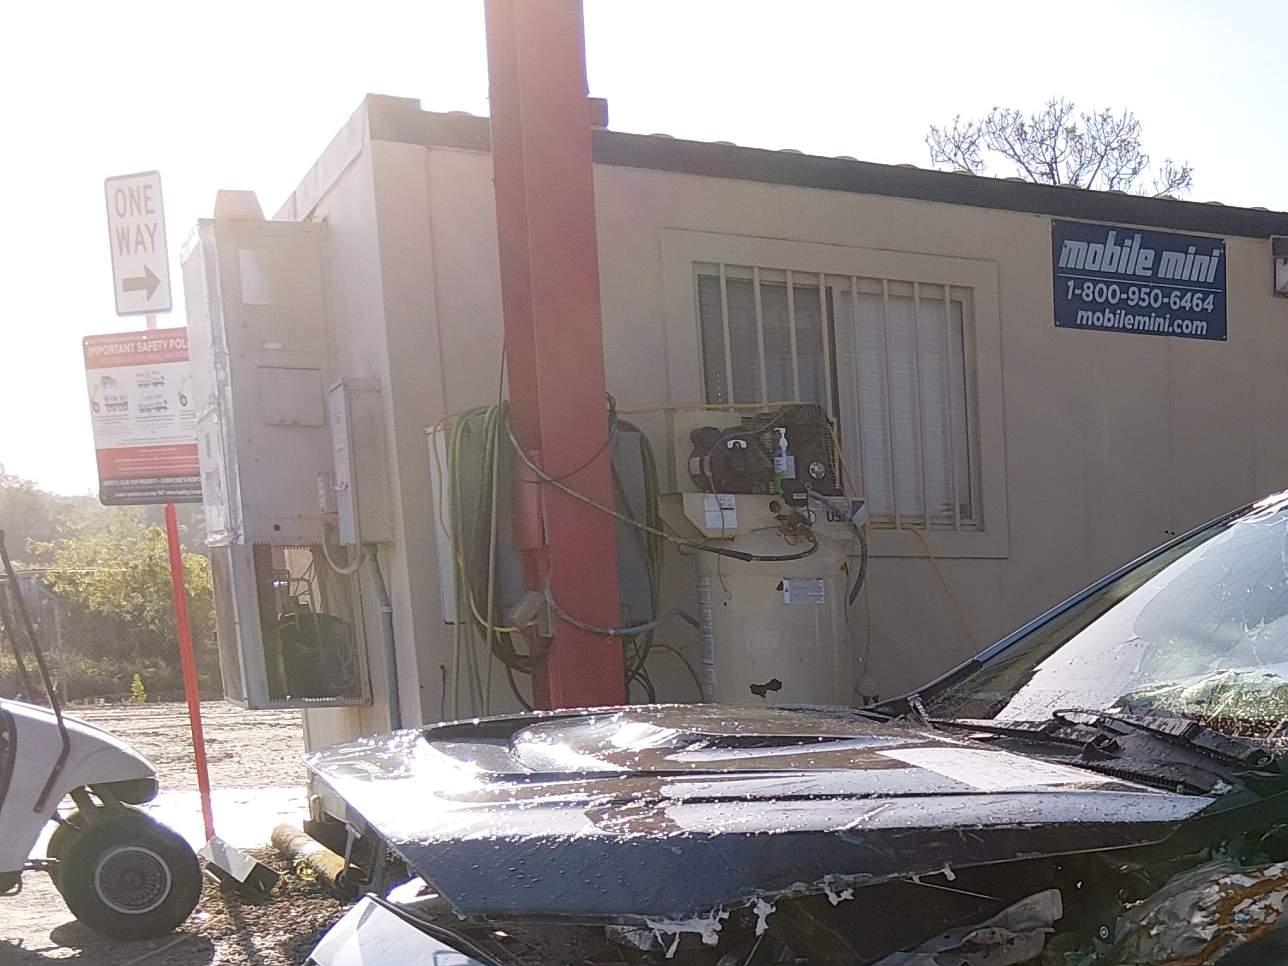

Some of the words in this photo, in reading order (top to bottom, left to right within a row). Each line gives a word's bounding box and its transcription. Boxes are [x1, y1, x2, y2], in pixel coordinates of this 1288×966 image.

[114, 184, 155, 218] ONE
[115, 222, 159, 256] WAY
[1059, 231, 1156, 277] mobile
[1157, 246, 1220, 283] mini
[1067, 280, 1215, 313] 1-800-950-6464
[1076, 308, 1208, 335] mobilemini.com
[88, 342, 135, 357] IMPORTANT
[136, 339, 167, 353] SAFETY
